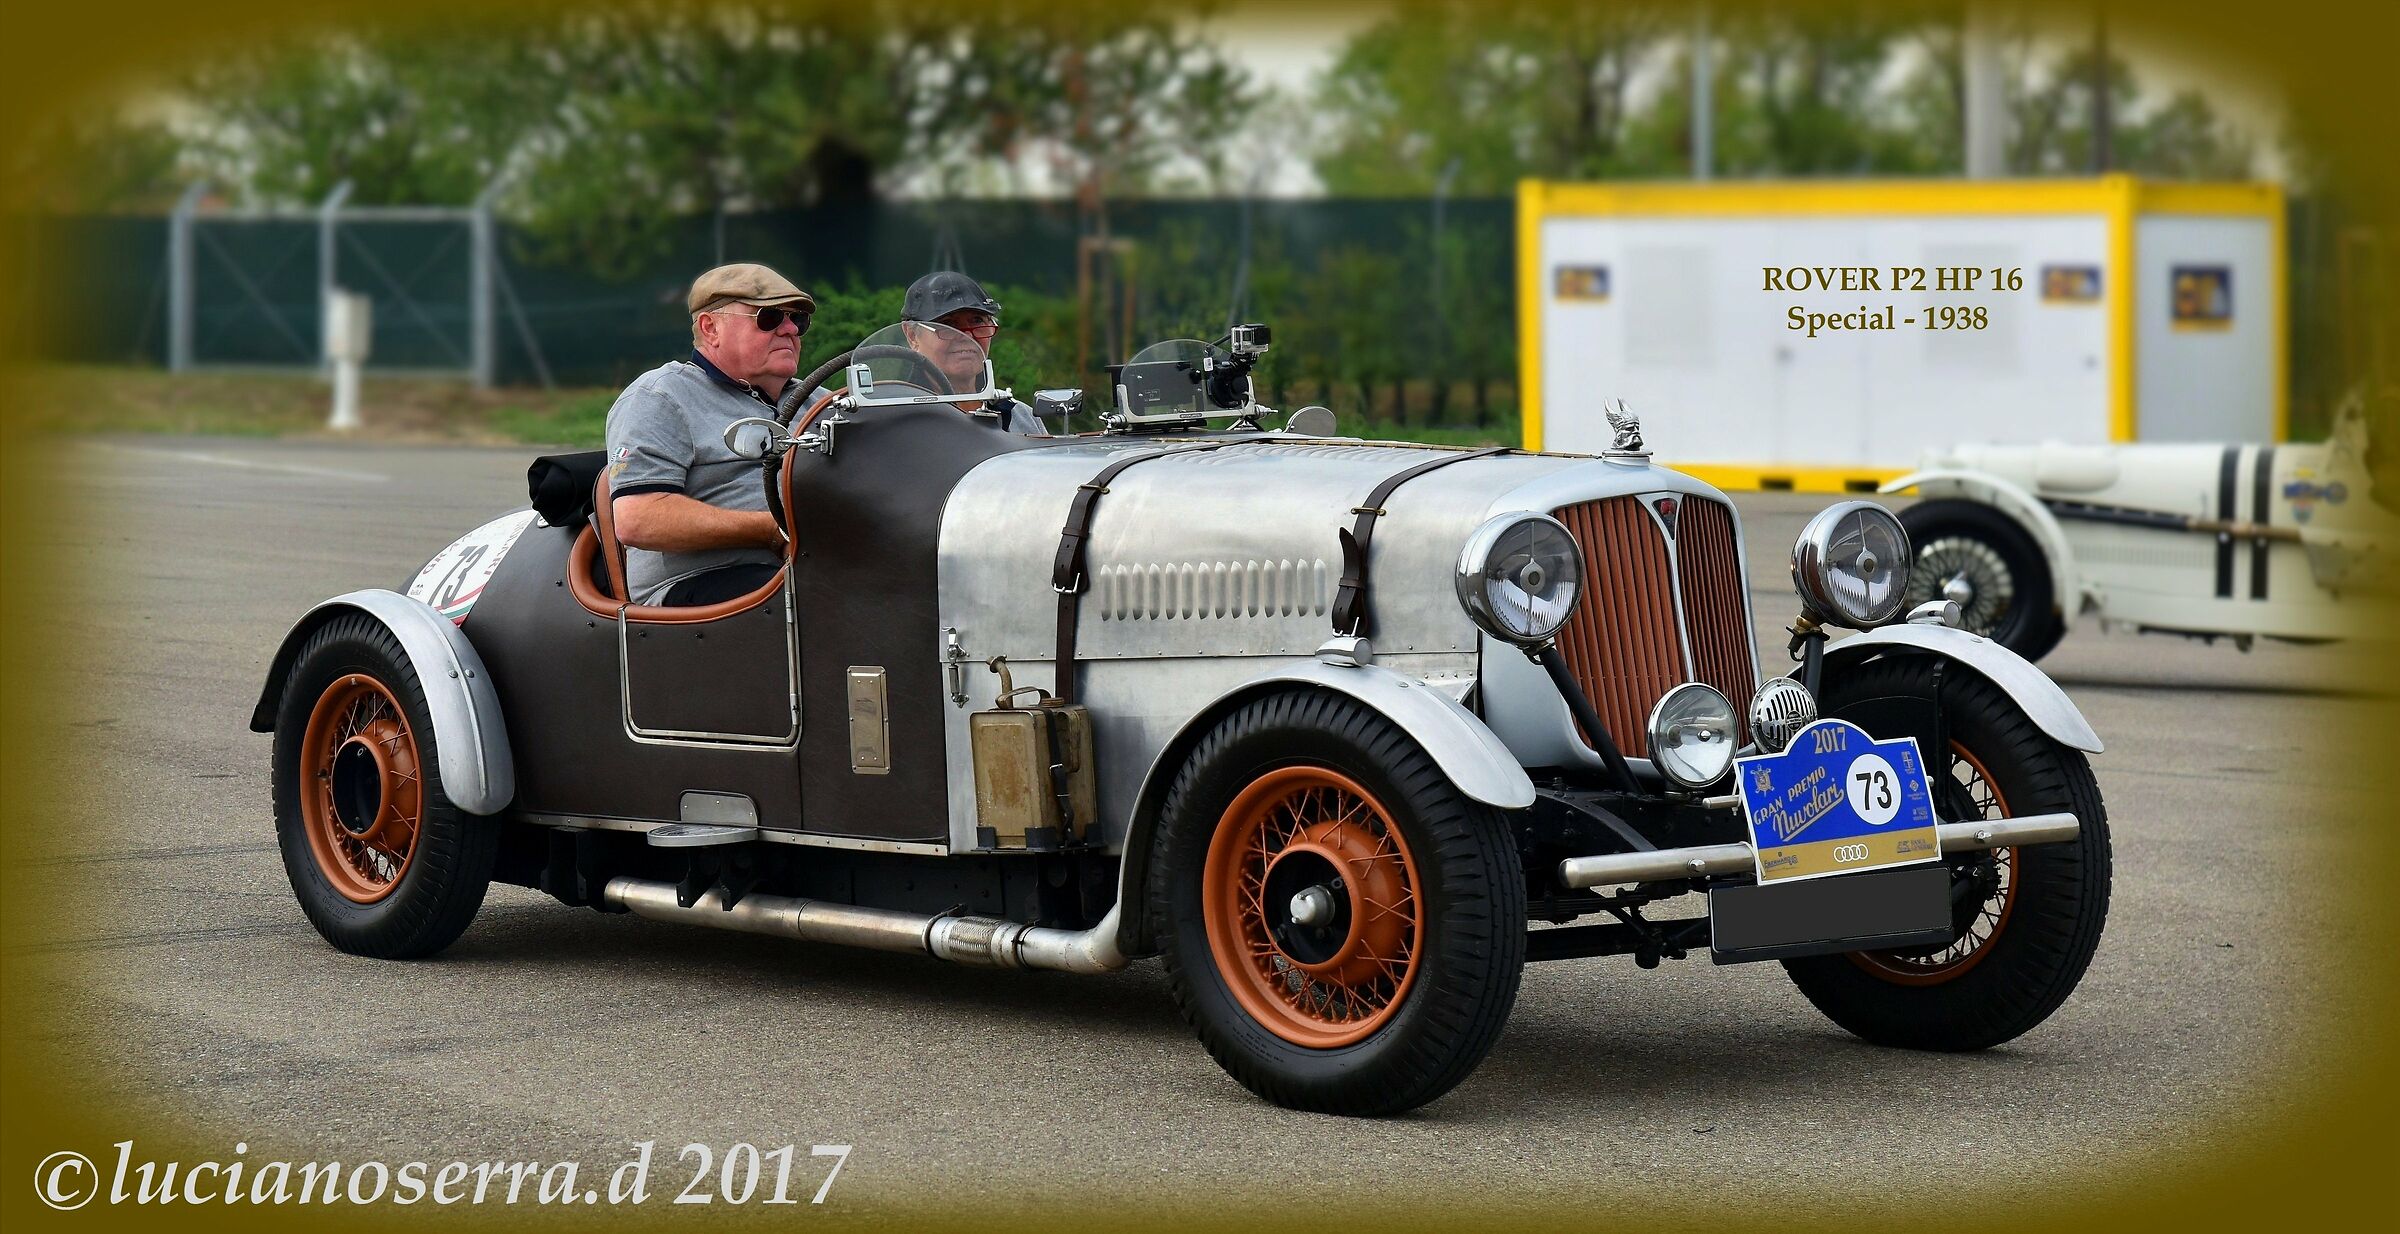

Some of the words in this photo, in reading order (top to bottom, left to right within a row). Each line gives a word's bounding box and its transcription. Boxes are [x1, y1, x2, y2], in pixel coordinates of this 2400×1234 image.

[427, 544, 489, 607] 73
[1811, 726, 1847, 754] 2017
[1753, 795, 1783, 825] GRAN
[1787, 766, 1826, 802] PREMIO
[1772, 777, 1845, 840] Nuvolari
[1856, 771, 1891, 811] 73
